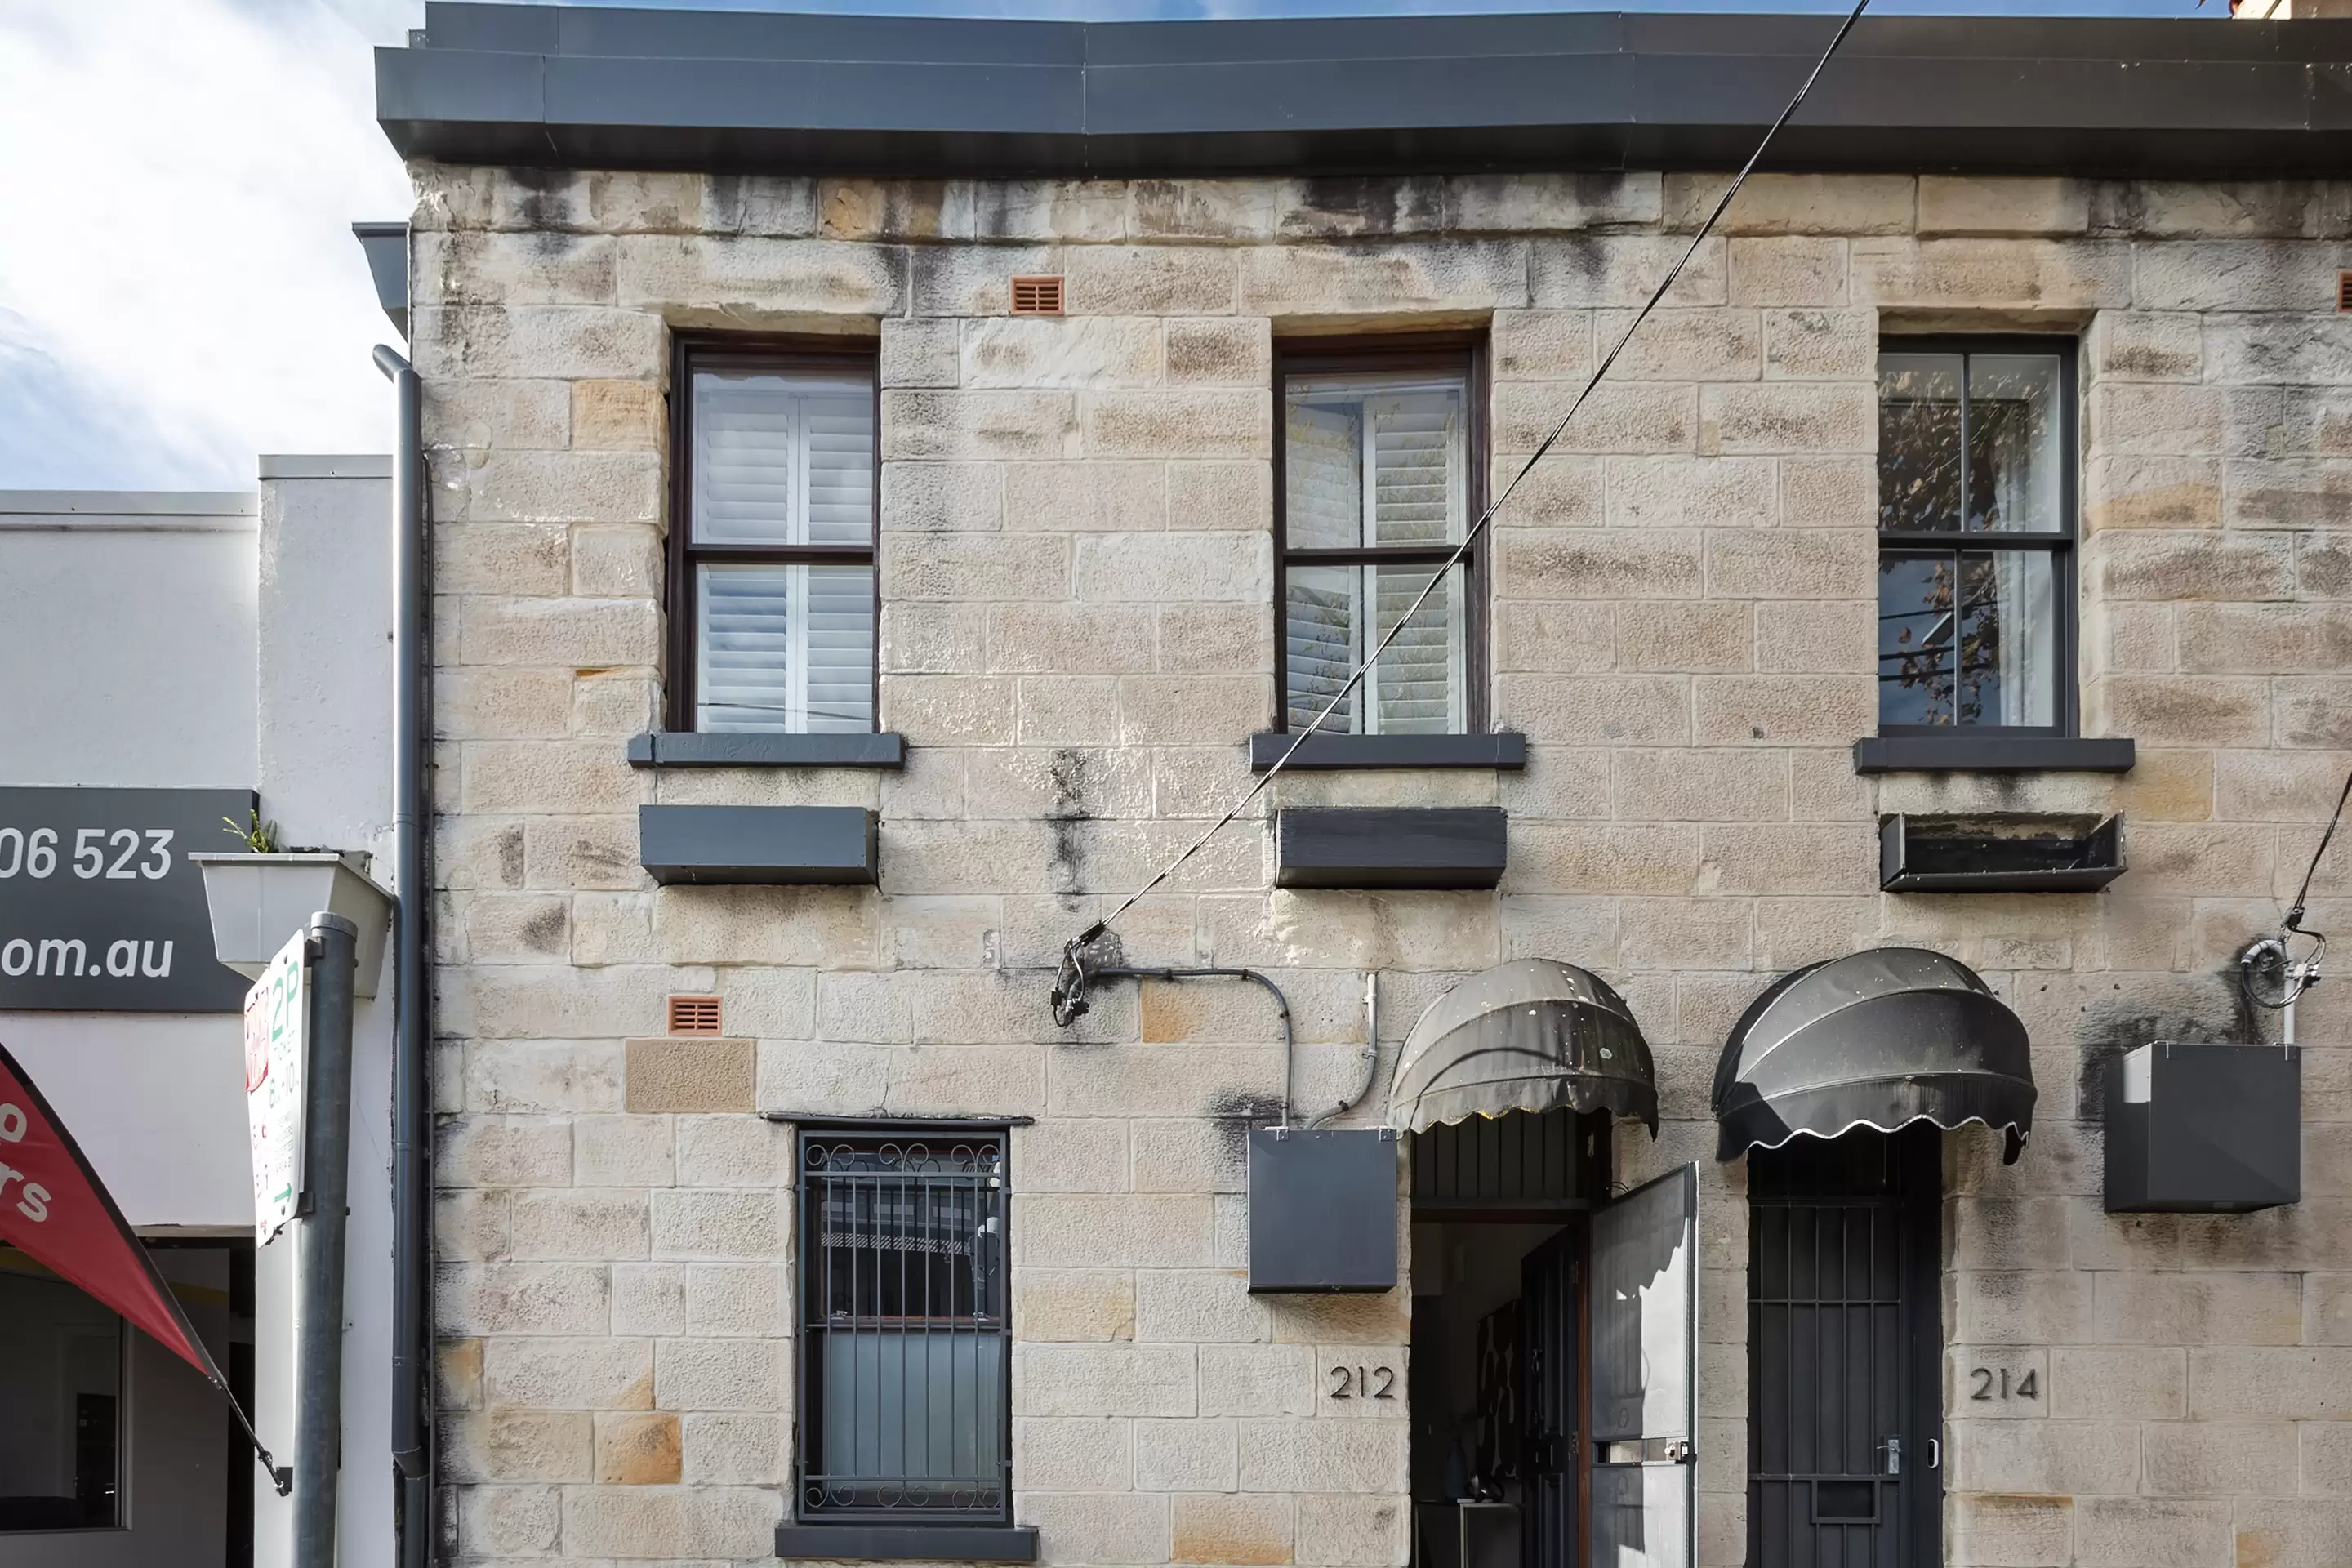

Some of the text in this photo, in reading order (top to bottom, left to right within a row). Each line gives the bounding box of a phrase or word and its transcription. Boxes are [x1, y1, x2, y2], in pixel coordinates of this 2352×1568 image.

[0, 827, 175, 880] 06 523
[2, 938, 174, 978] om.au
[271, 960, 299, 1043] 2P
[1330, 1366, 1395, 1398] 212
[1970, 1367, 2038, 1400] 214
